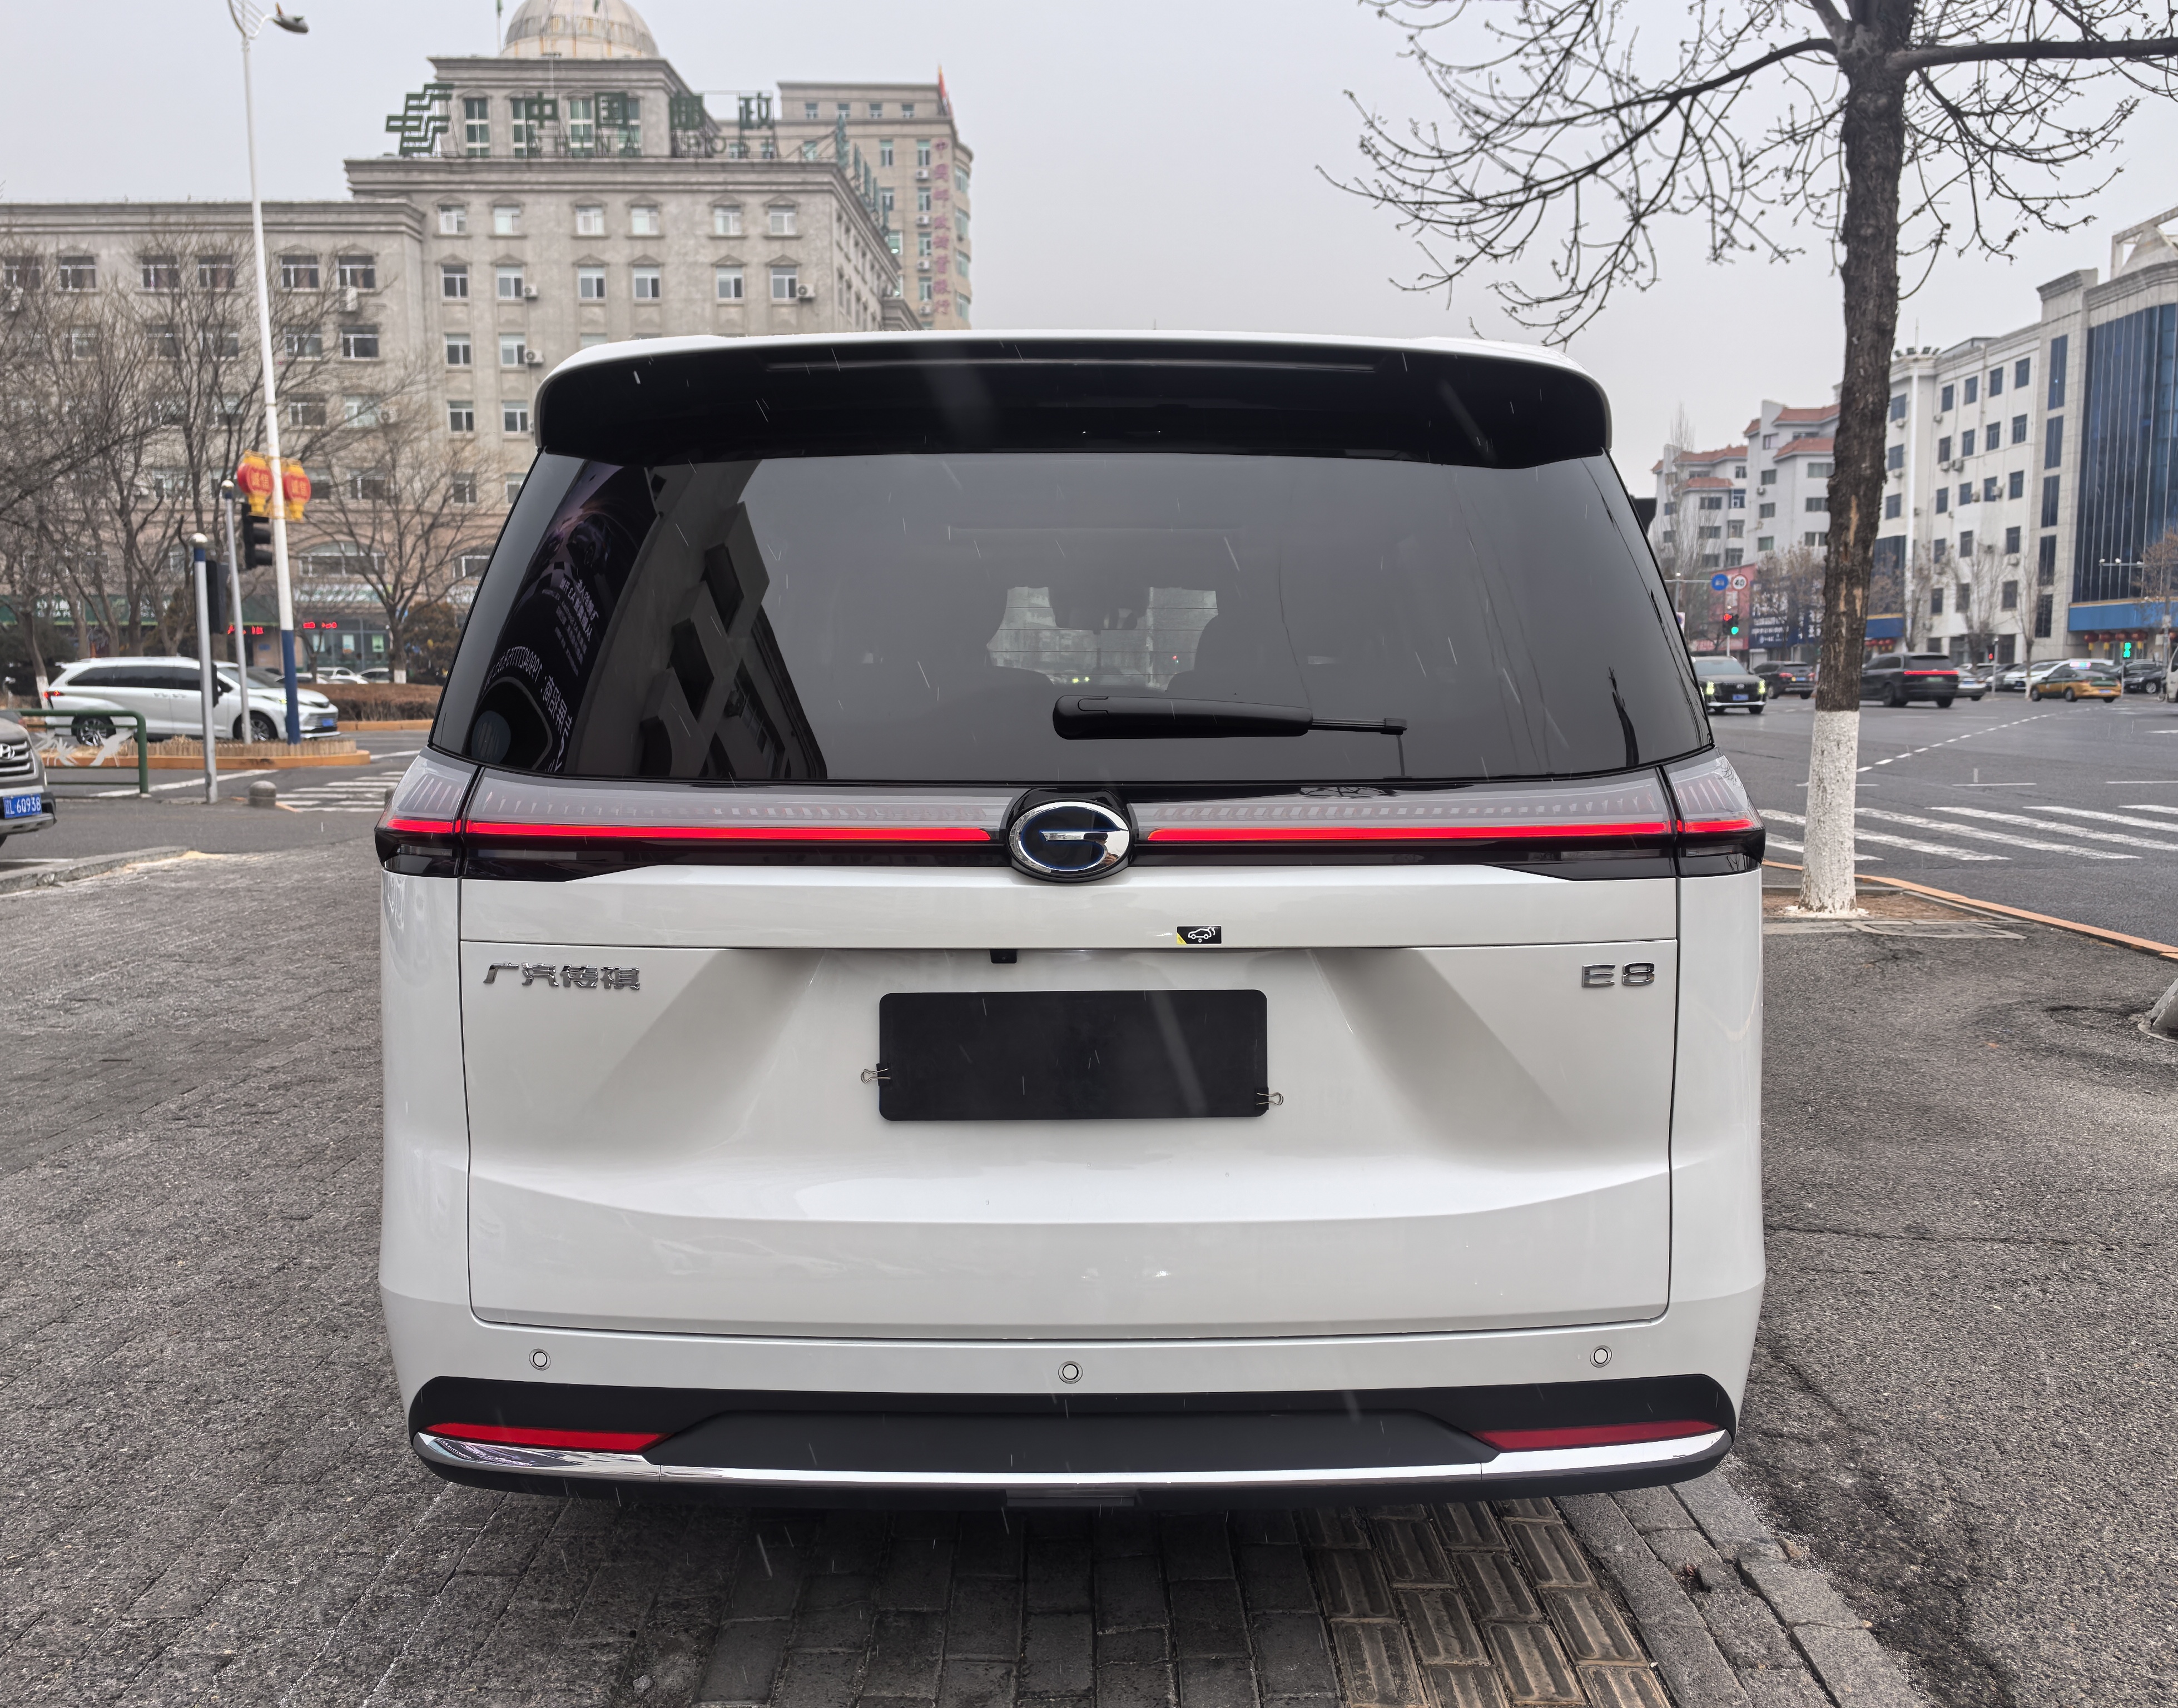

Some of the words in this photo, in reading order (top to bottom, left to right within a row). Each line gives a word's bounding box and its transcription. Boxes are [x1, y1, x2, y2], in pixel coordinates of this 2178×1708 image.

[1735, 578, 1745, 587] 40
[483, 961, 640, 990] 广汽传祺
[1581, 961, 1655, 987] E8
